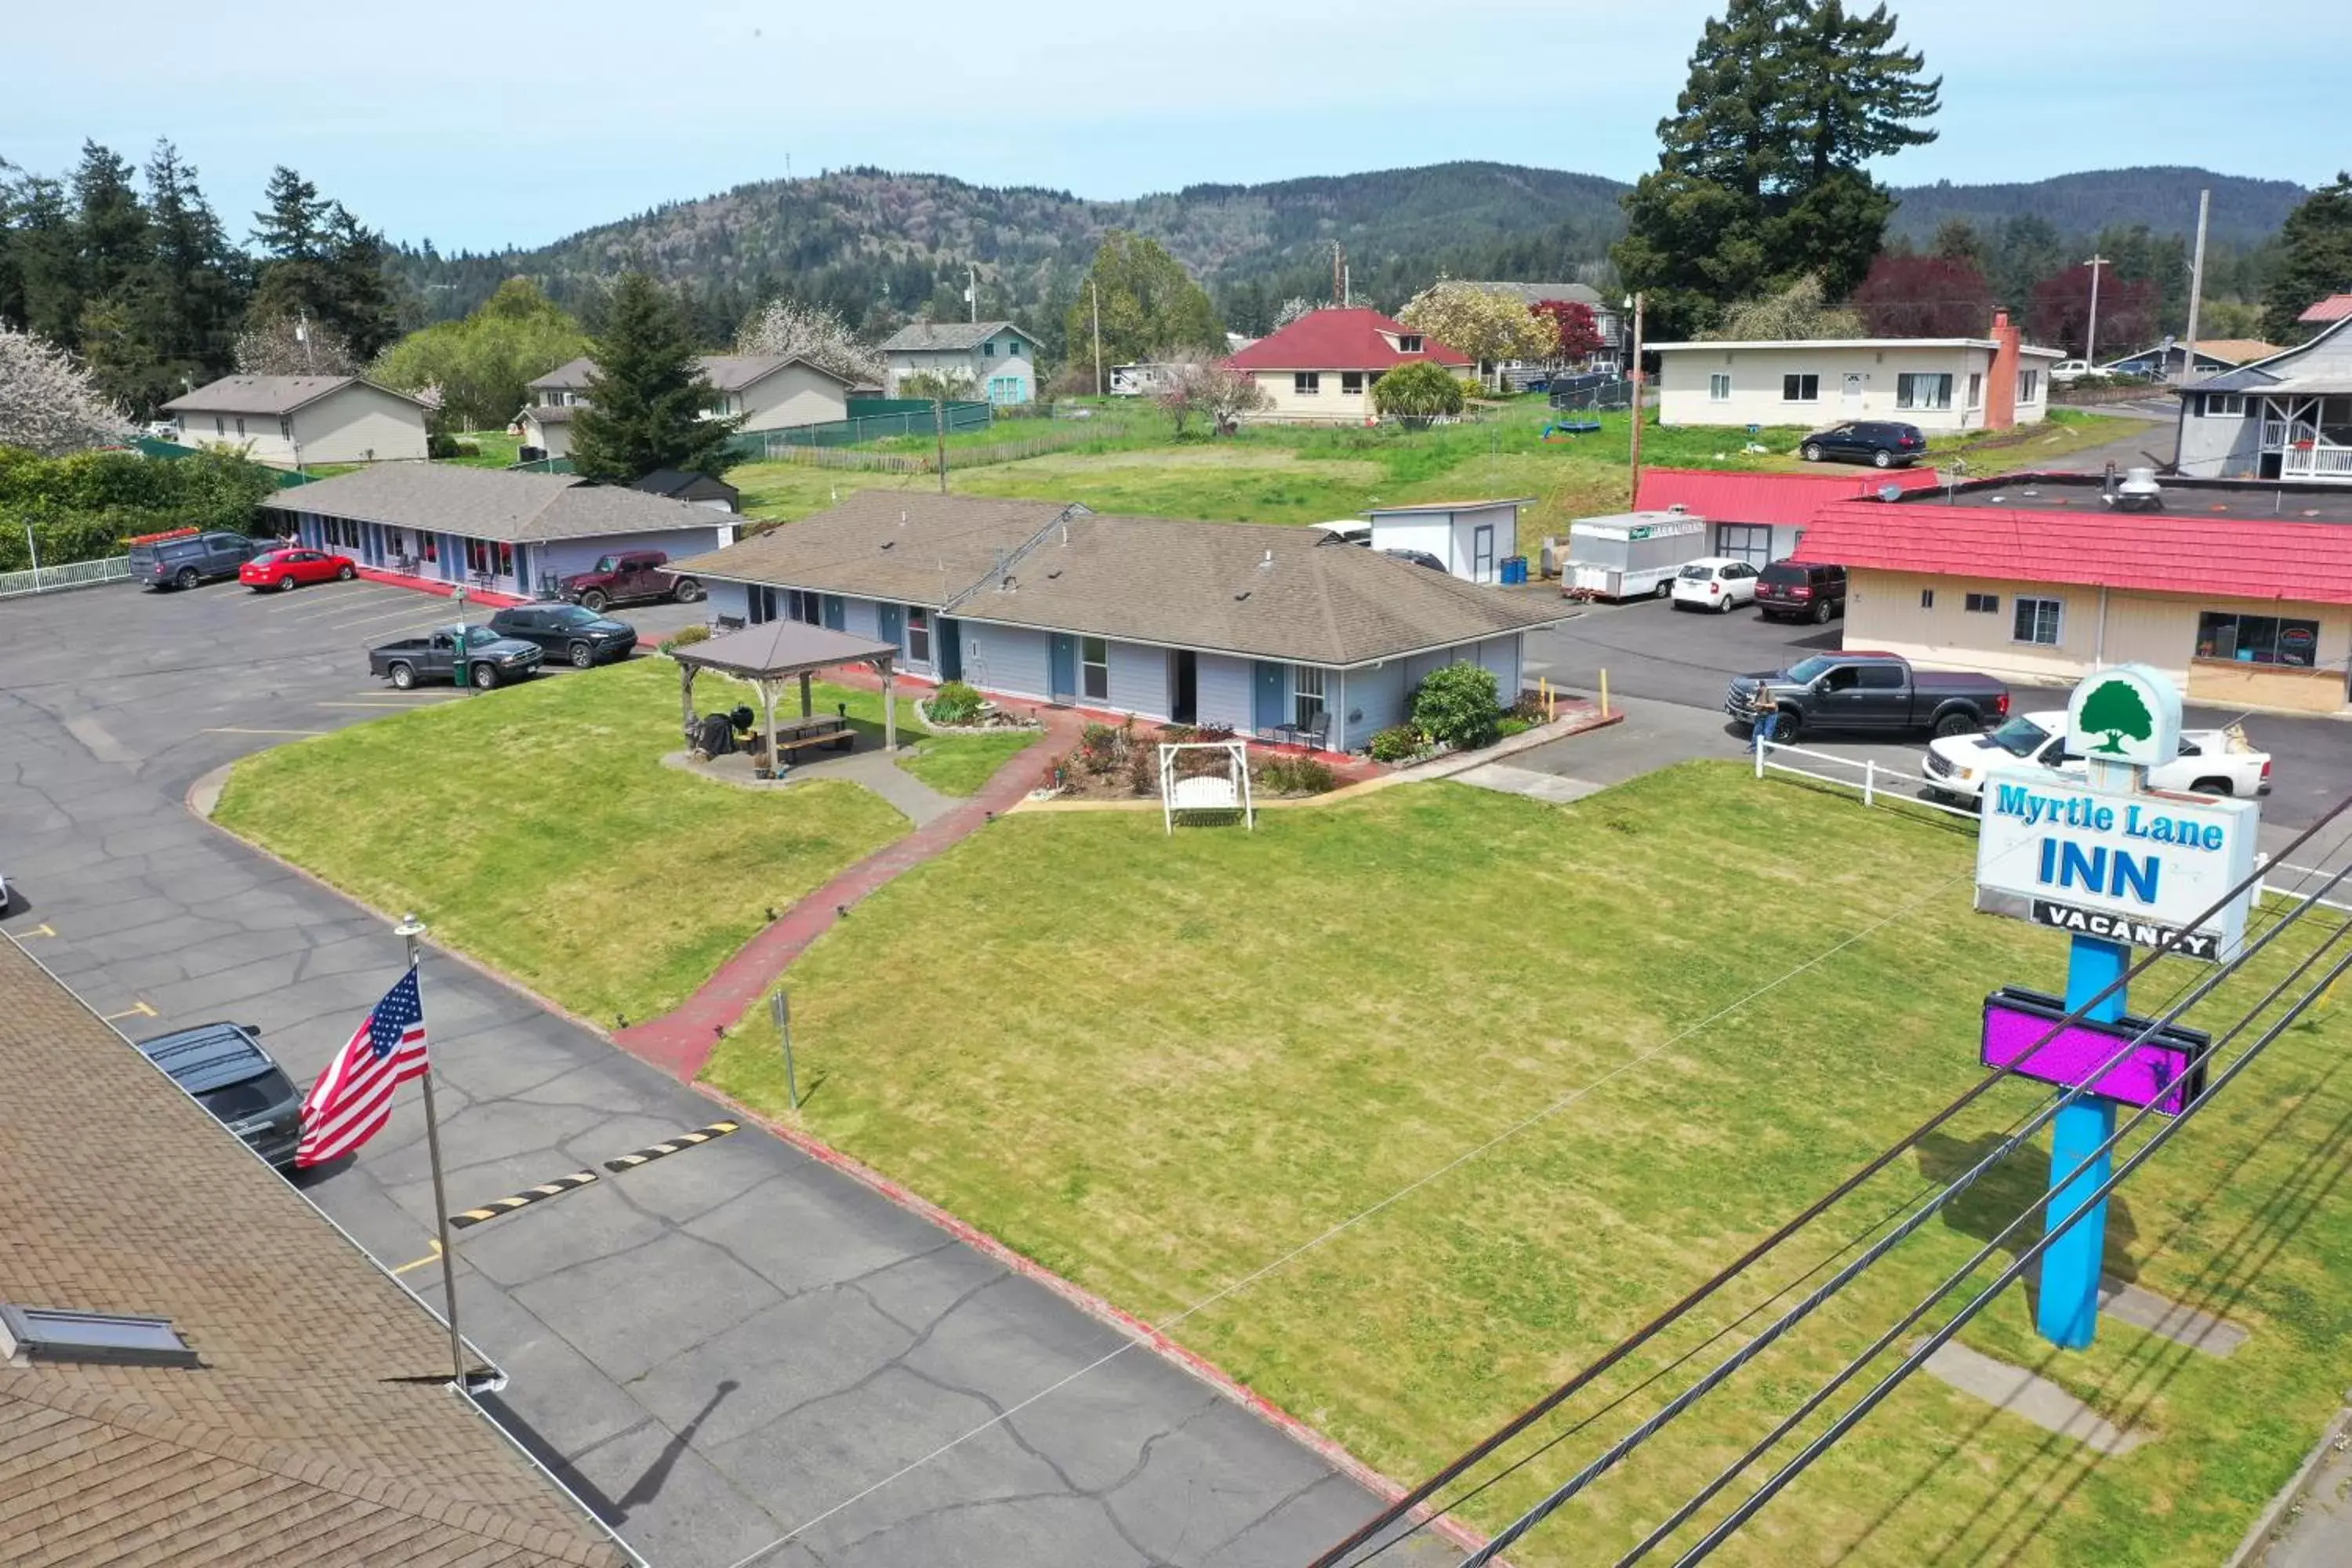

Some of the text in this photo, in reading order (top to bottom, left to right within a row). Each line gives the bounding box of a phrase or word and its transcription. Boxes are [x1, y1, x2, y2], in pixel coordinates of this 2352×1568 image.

[1996, 784, 2223, 851] Myrtle Lane
[2038, 837, 2161, 904] INN
